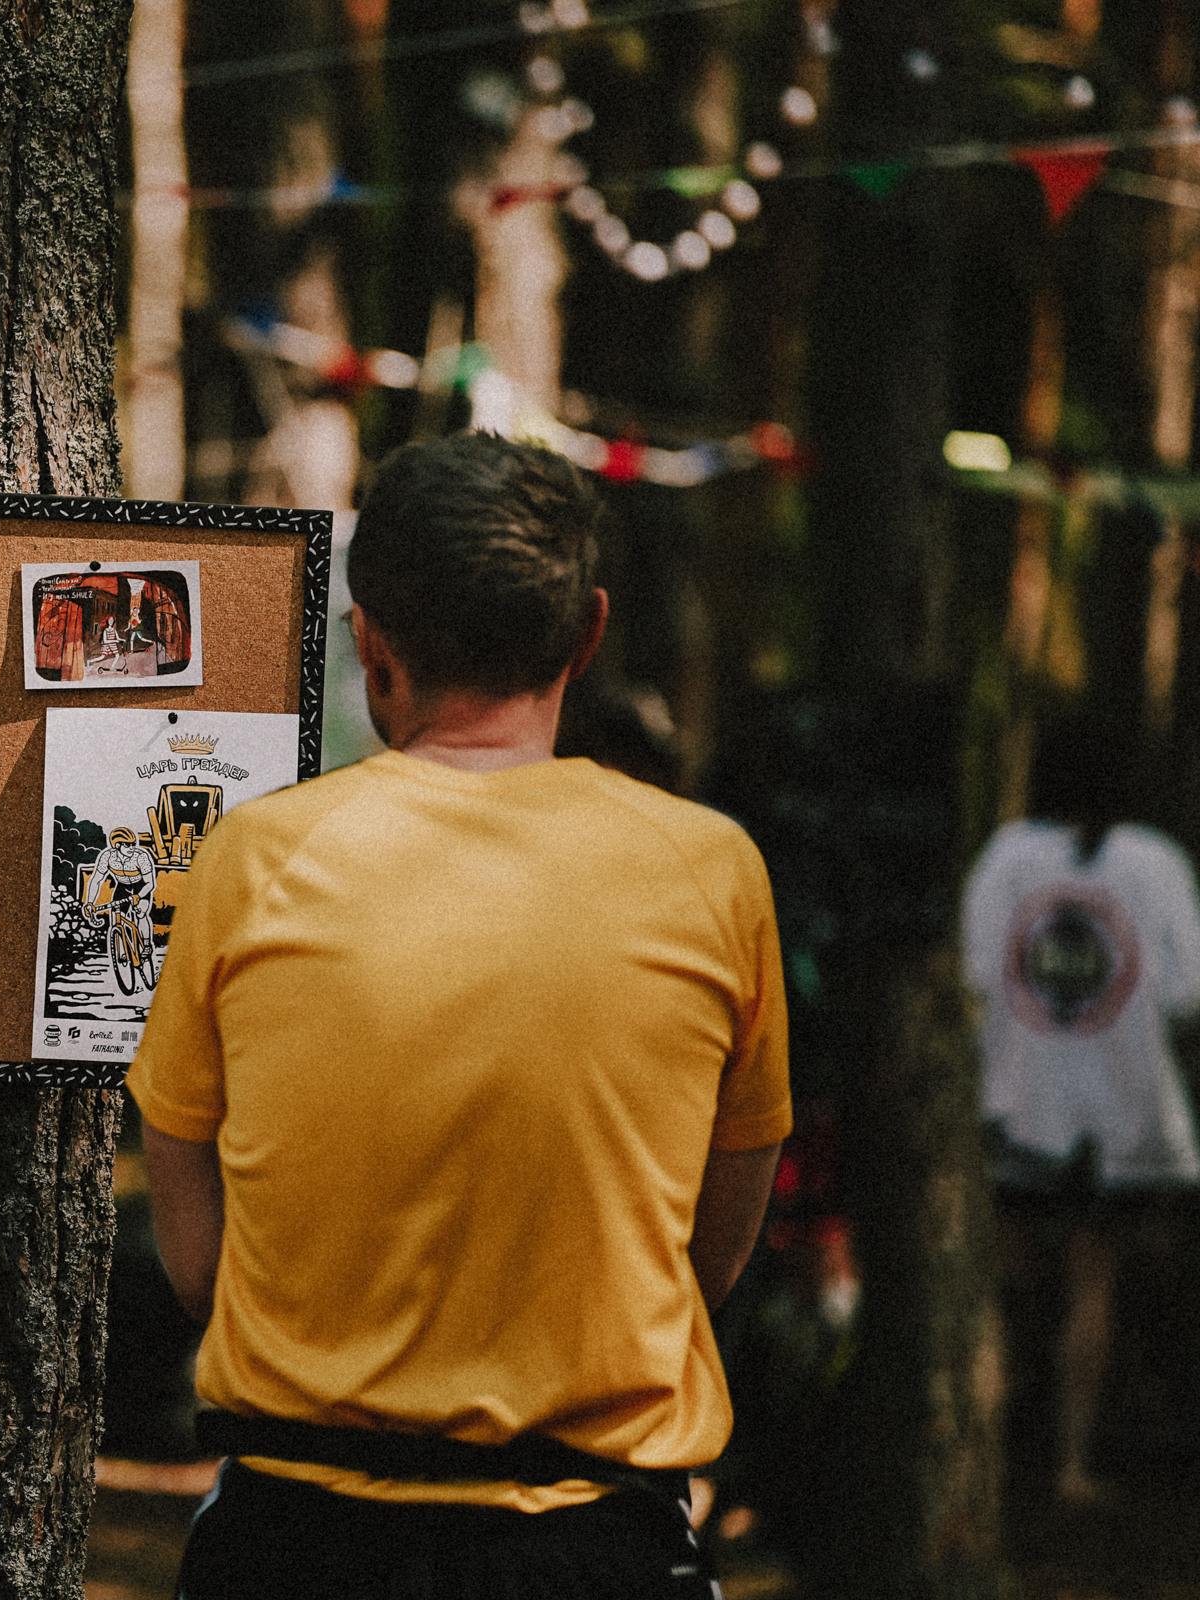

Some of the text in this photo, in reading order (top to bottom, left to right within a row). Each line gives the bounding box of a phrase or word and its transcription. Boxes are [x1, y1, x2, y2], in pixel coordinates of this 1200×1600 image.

[136, 757, 250, 781] ЦАРЬ ГРЕЙДЕР
[91, 1044, 125, 1054] FATRACING
